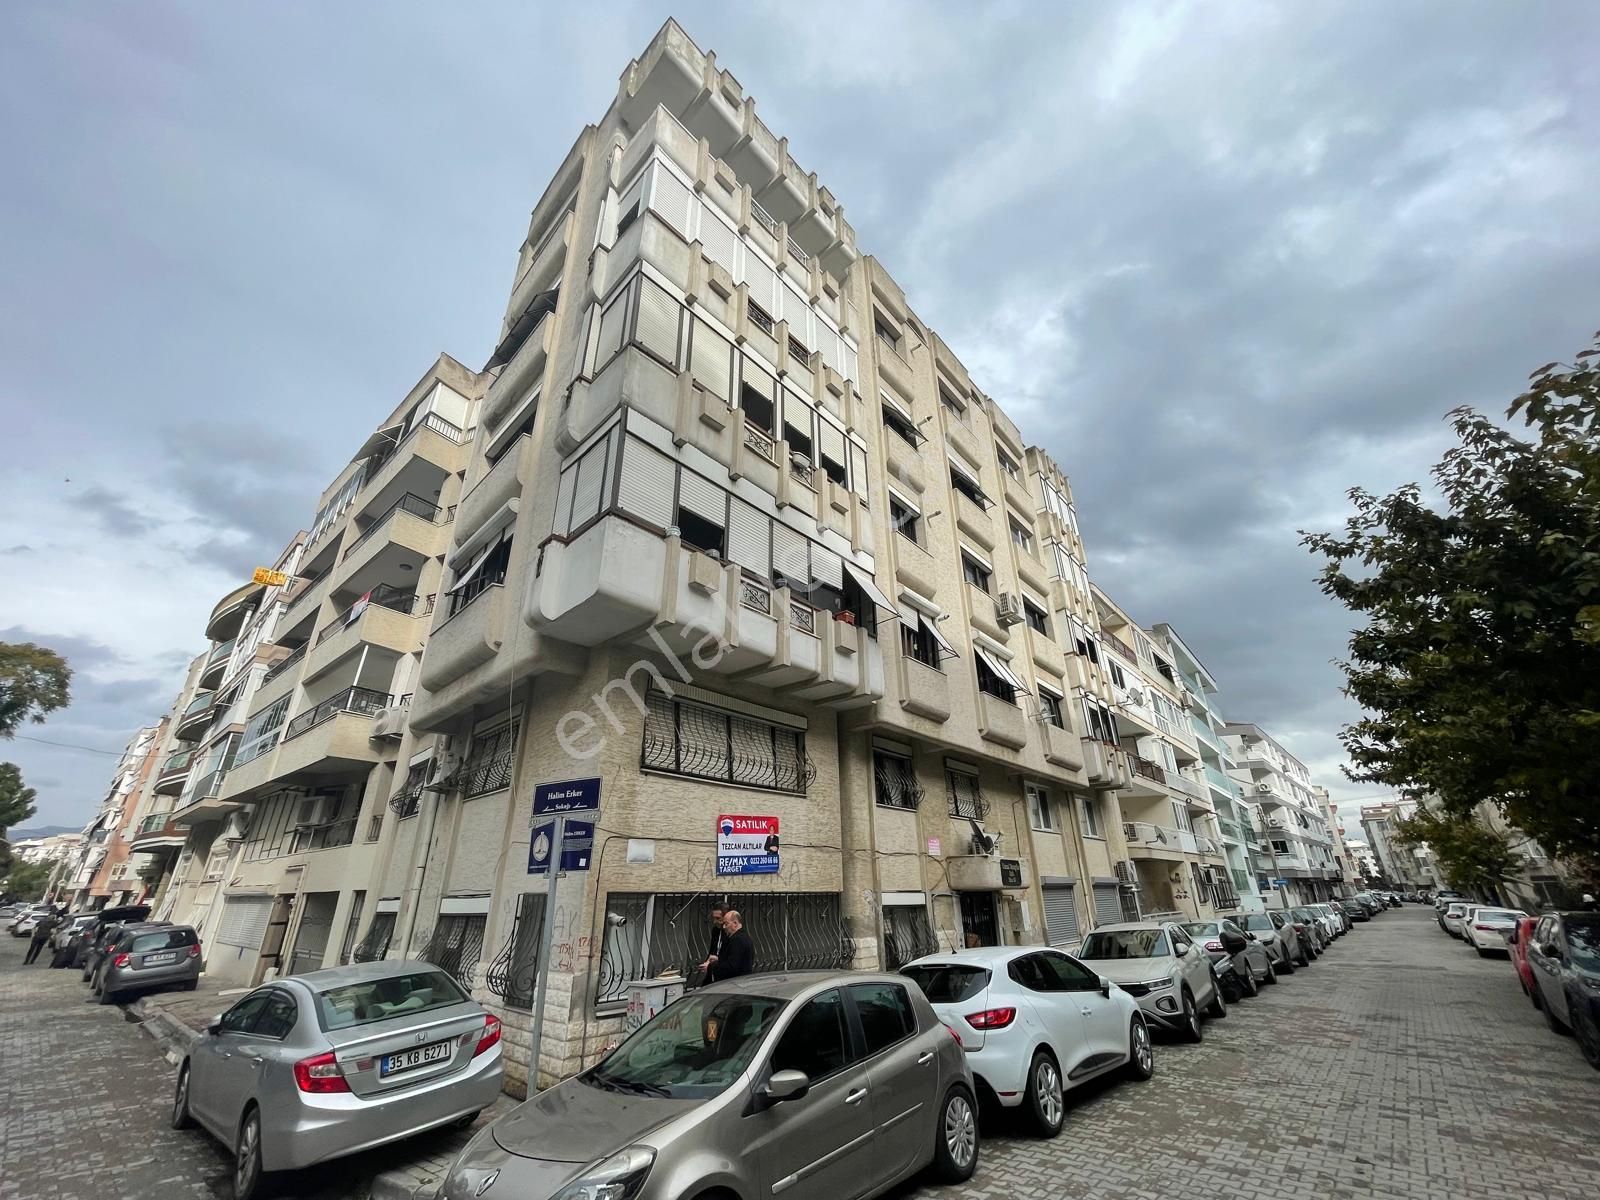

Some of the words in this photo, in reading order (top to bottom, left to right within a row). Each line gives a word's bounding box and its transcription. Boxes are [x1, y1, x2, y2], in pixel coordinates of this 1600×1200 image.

[547, 792, 565, 800] Halim
[566, 789, 583, 798] Erker
[735, 820, 768, 829] SATILIK
[719, 857, 749, 867] RE/MAX
[389, 1055, 403, 1070] 35
[407, 1051, 420, 1066] KB
[424, 1043, 448, 1061] 6271
